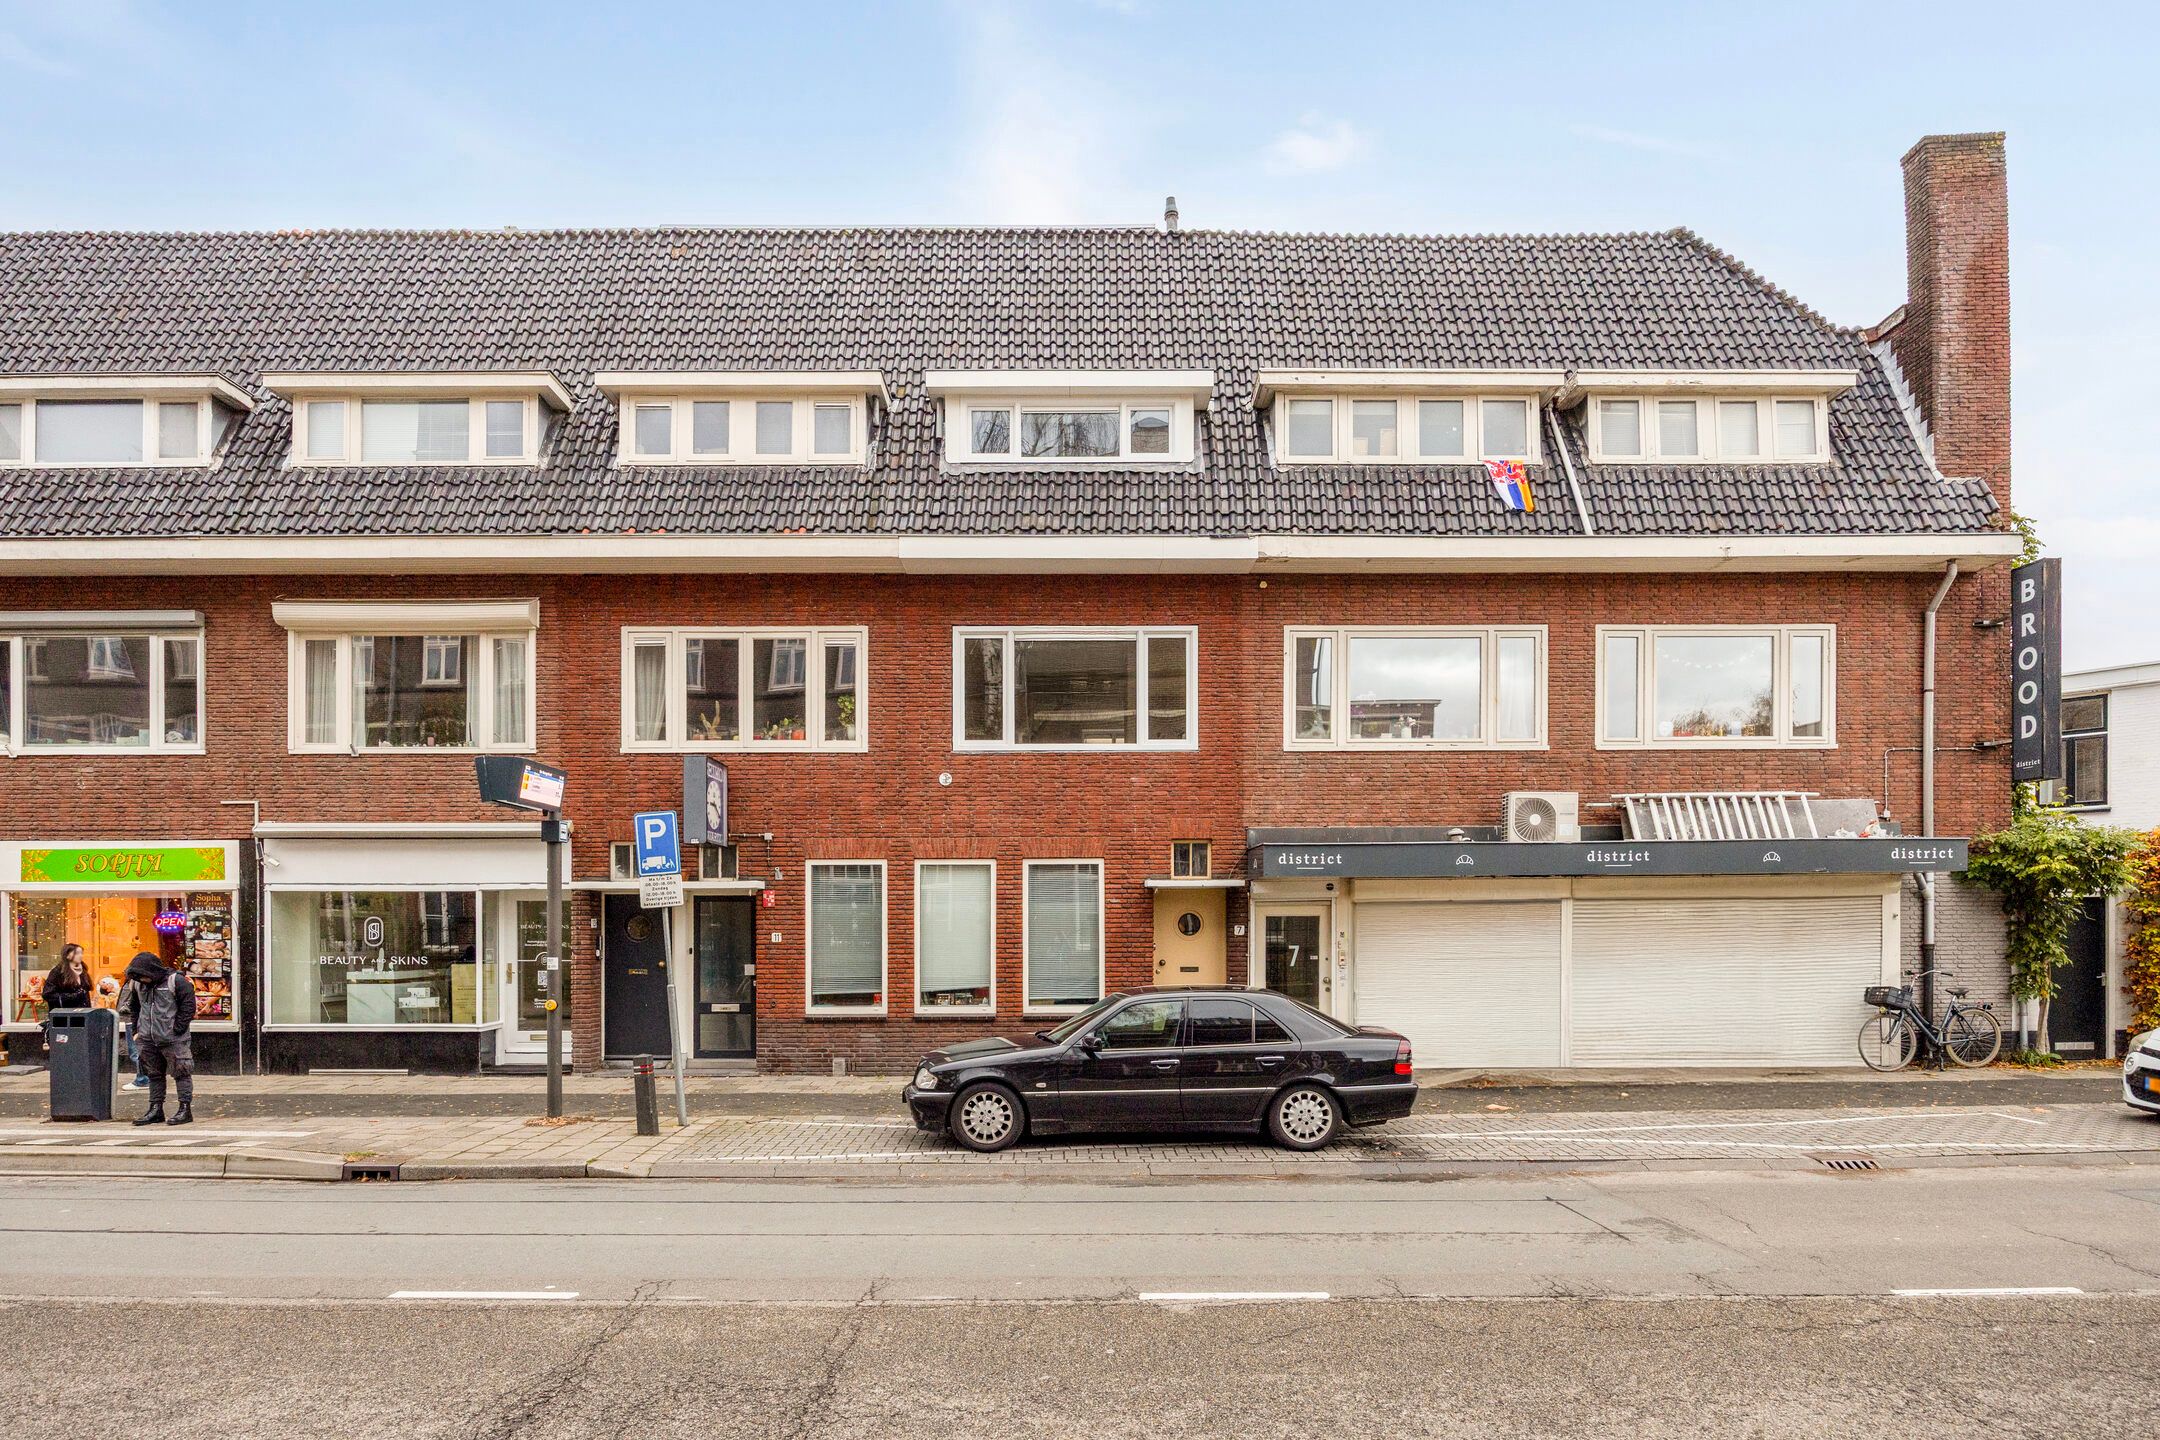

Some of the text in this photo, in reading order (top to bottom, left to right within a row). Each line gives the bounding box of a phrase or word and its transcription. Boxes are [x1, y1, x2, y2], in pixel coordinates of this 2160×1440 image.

[2018, 578, 2039, 740] BROOD
[2016, 759, 2041, 768] district
[644, 818, 667, 850] P
[1278, 852, 1342, 865] district
[1586, 849, 1650, 862] district
[1890, 847, 1954, 859] district
[74, 851, 164, 878] SOPHA
[196, 893, 222, 902] Sopha
[155, 917, 185, 926] OPEN
[320, 955, 367, 965] BEAUTY
[390, 955, 428, 965] SKINS
[1288, 944, 1300, 967] 7
